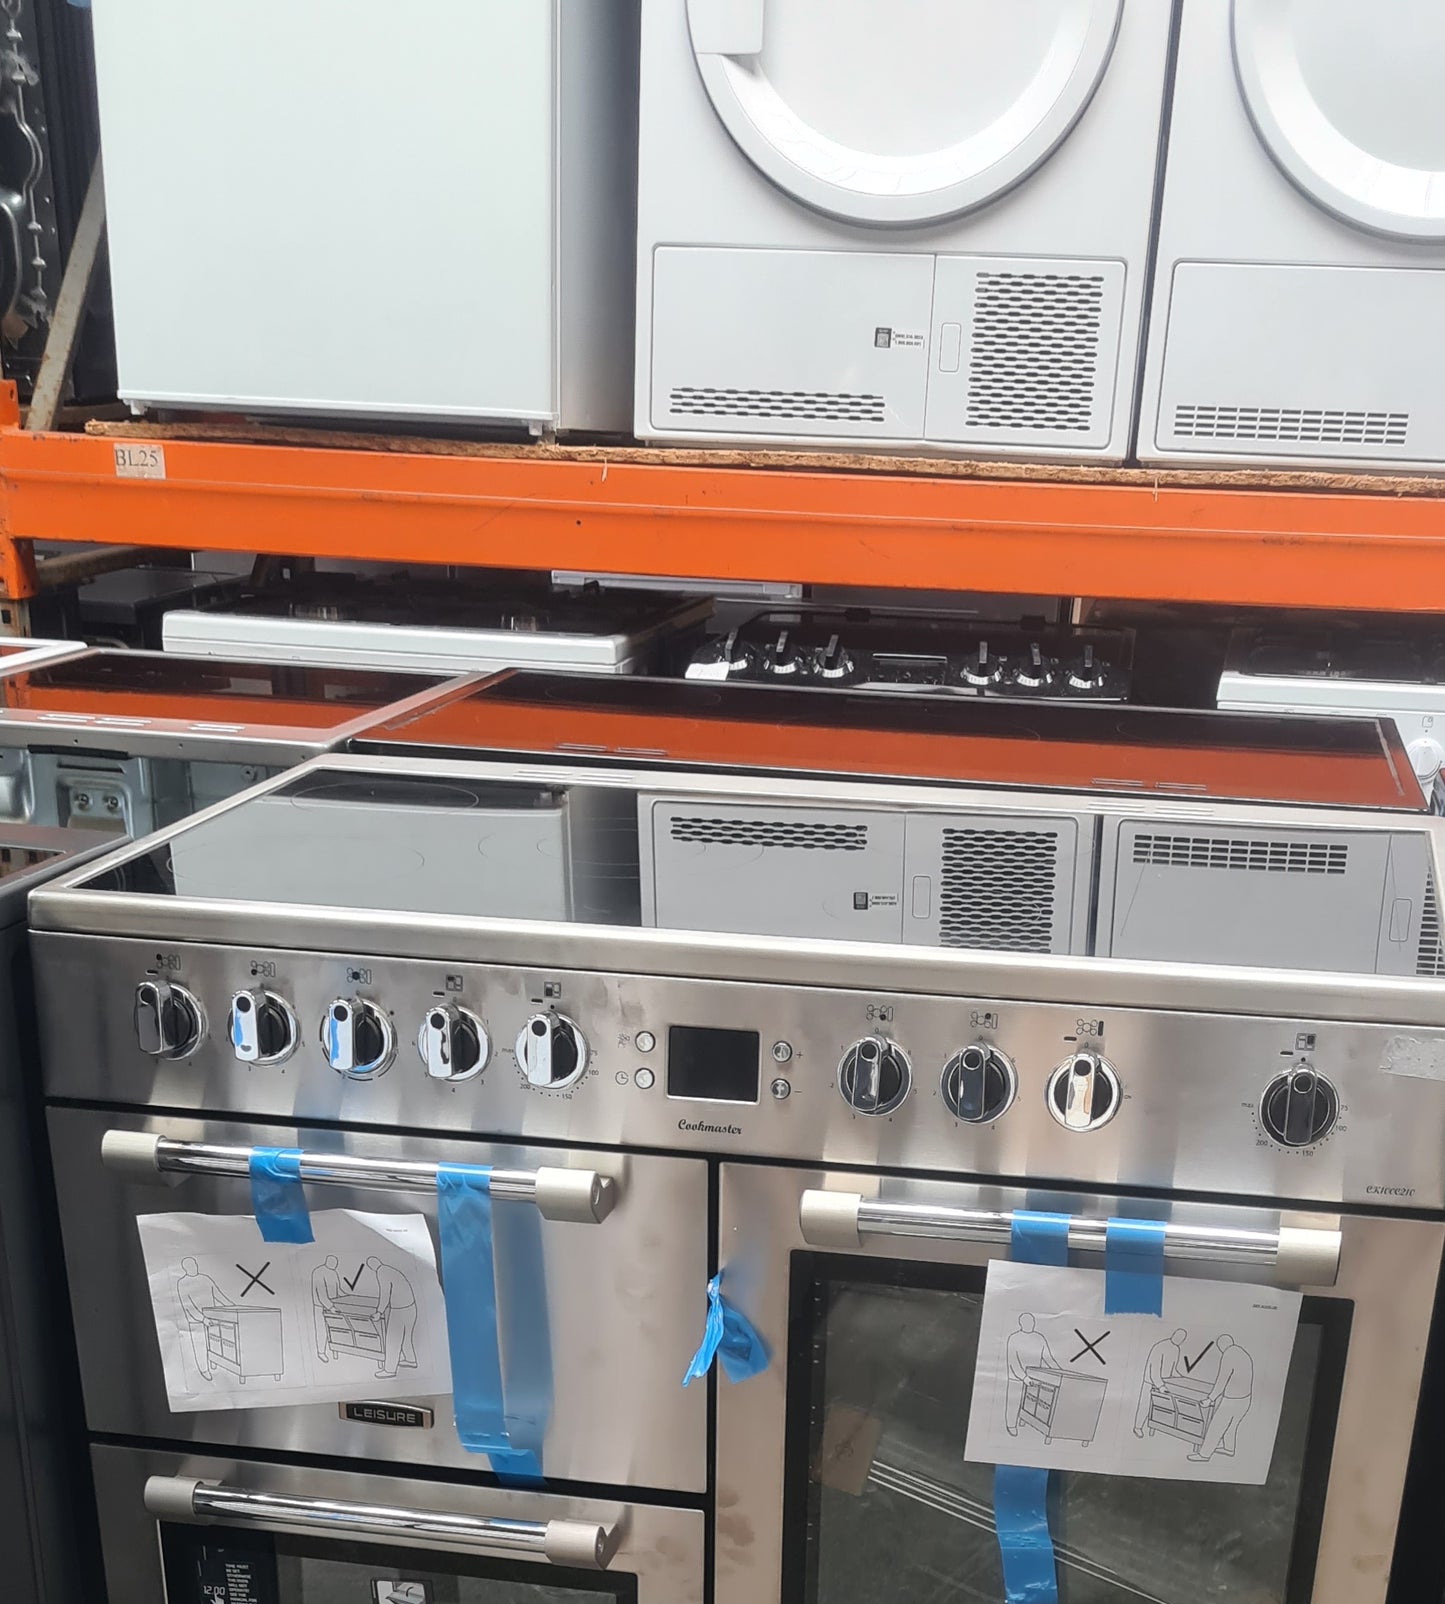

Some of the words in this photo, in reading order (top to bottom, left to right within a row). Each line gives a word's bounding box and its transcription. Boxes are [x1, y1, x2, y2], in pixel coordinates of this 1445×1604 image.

[115, 449, 158, 467] BL25
[678, 1119, 742, 1134] Cookmaster
[353, 1408, 416, 1423] LEISURE
